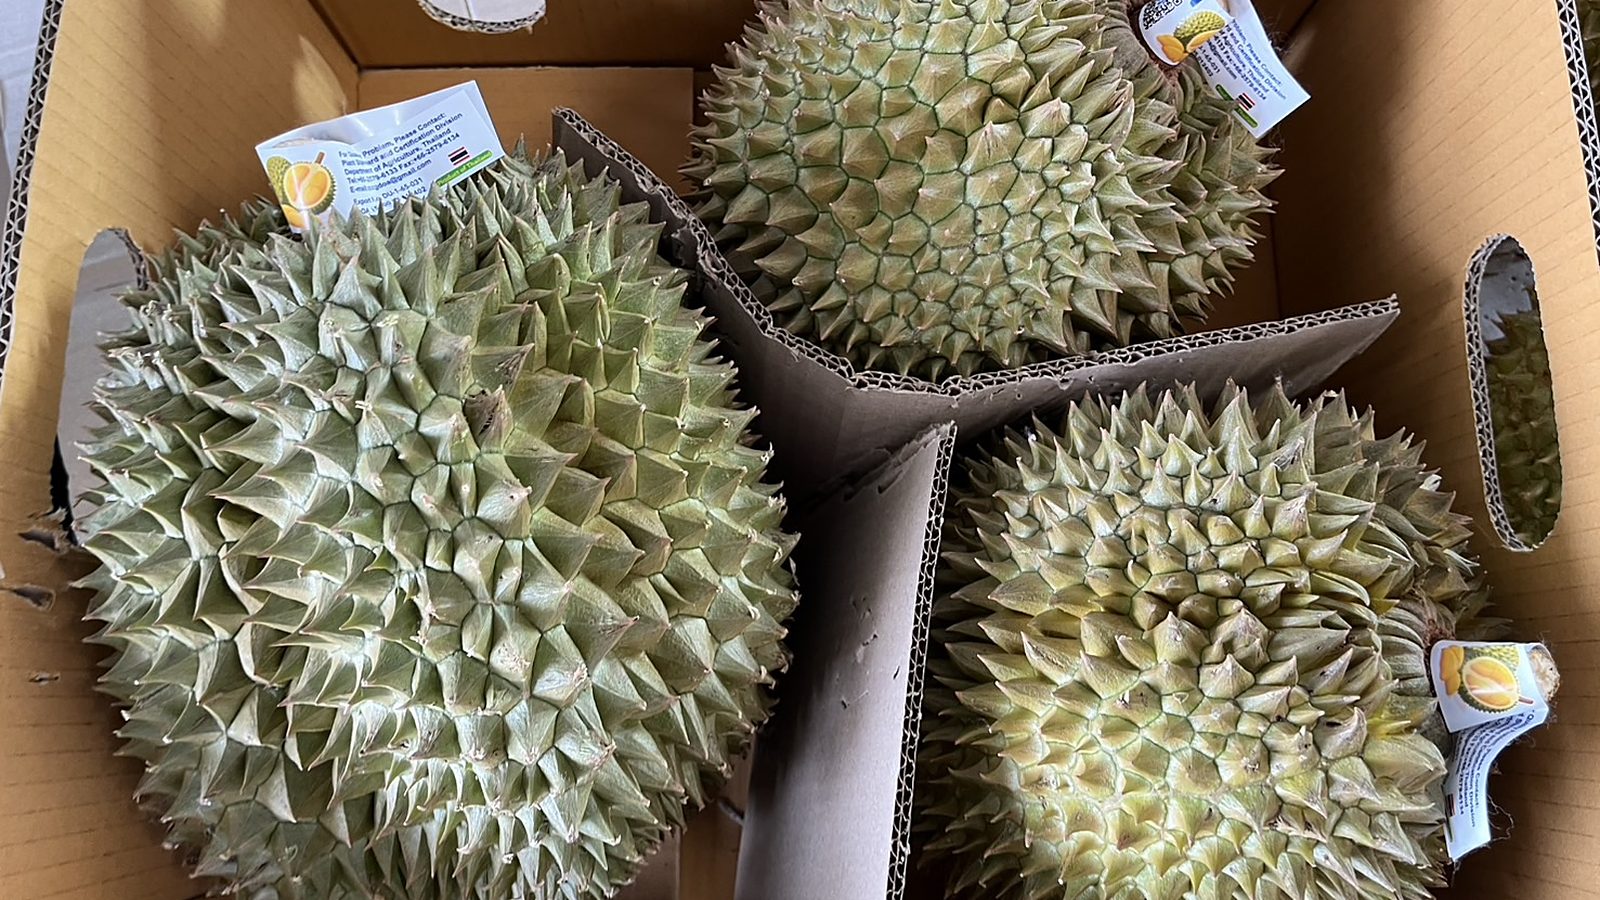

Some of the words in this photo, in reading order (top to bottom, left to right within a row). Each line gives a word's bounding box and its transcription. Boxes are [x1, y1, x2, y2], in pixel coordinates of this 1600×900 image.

[1231, 18, 1247, 45] roblem,
[1246, 43, 1262, 64] Please
[1238, 44, 1265, 79] Certification
[1264, 78, 1287, 99] Division
[1246, 69, 1270, 93] Thailand
[362, 142, 395, 158] Problem,
[393, 129, 417, 144] Please
[417, 112, 447, 131] Contact:
[373, 164, 381, 173] of
[422, 128, 452, 147] Thailand
[393, 128, 435, 153] Certification
[434, 112, 463, 131] Division
[398, 132, 460, 170] Fax:+66-2579-6134
[381, 177, 424, 199] DU-1-65-031
